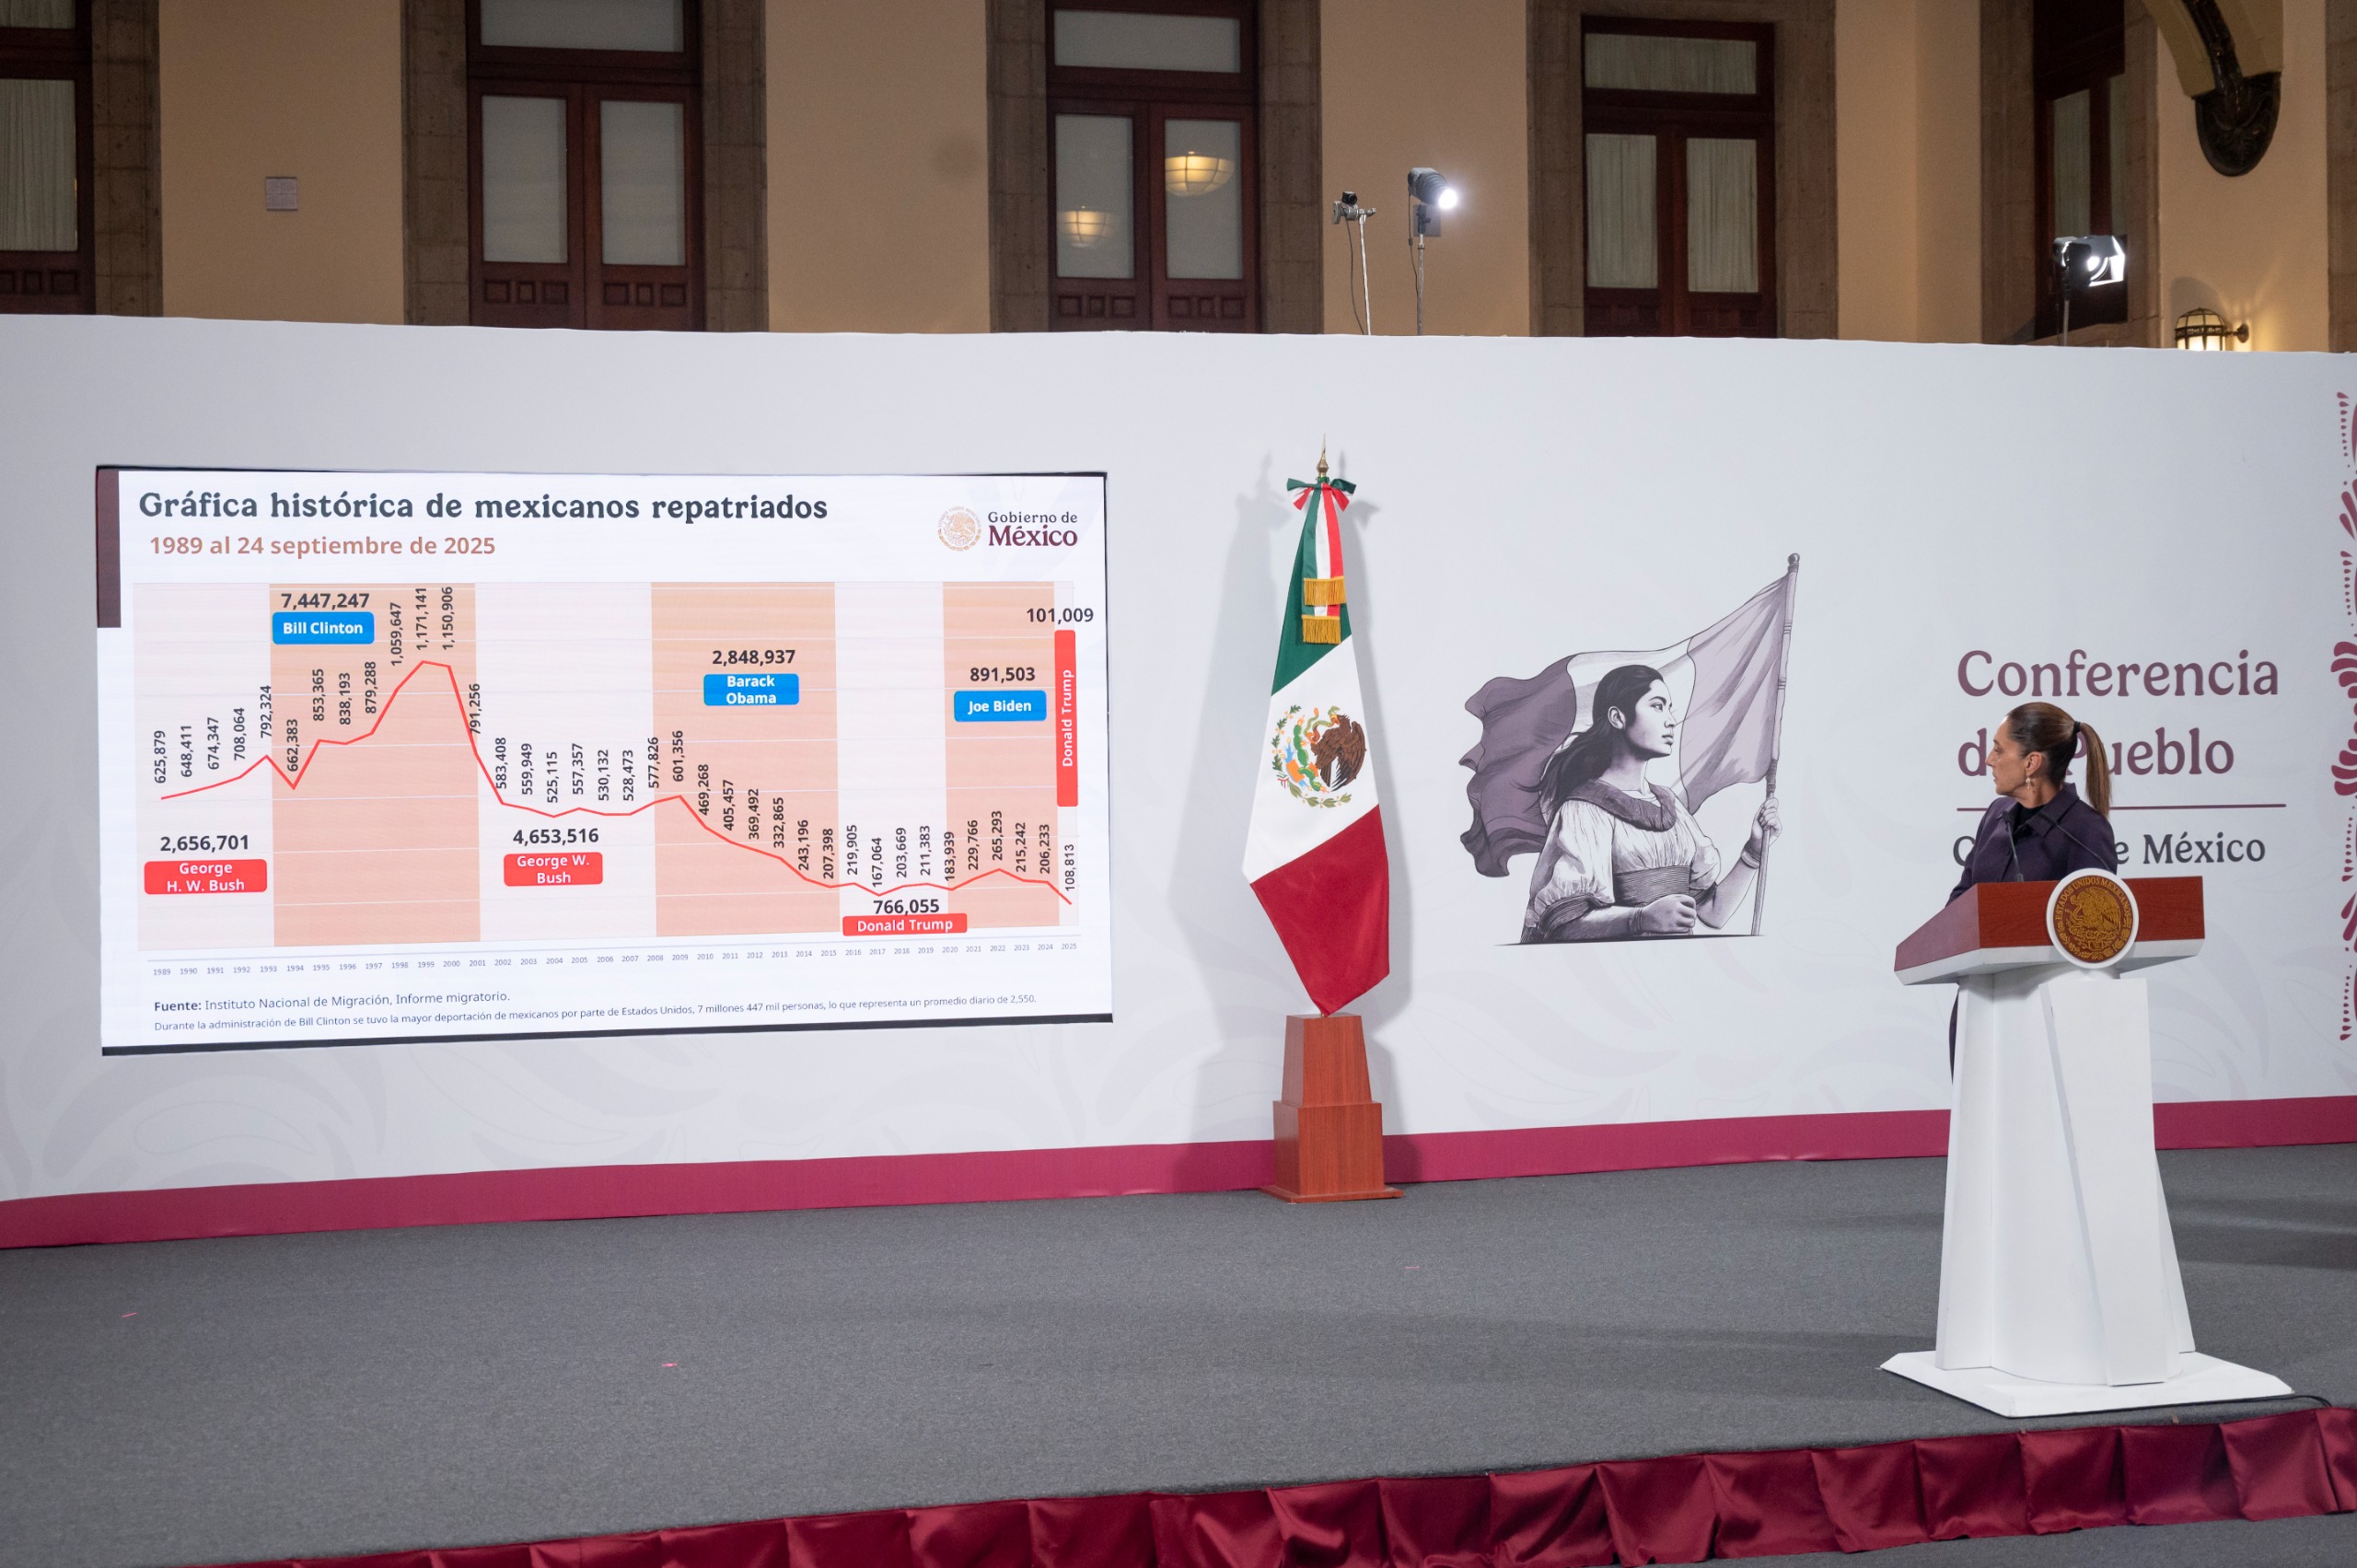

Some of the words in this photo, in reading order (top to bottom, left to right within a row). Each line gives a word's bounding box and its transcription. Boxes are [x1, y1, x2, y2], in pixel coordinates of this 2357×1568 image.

[139, 489, 258, 517] Gráfica
[270, 490, 413, 518] histórica
[425, 492, 462, 518] de
[474, 493, 640, 519] mexicanos
[651, 494, 828, 525] repatriados
[987, 511, 1057, 524] Gobierno
[1061, 511, 1078, 524] de
[150, 536, 203, 554] 1989
[210, 536, 230, 554] al
[238, 537, 264, 554] 24
[271, 536, 402, 560] septiembre
[410, 536, 437, 555] de
[444, 537, 495, 555] 2025
[988, 524, 1078, 547] México
[280, 592, 371, 611] 7,447,247
[283, 621, 307, 634] Bill
[310, 621, 363, 634] Clinton
[414, 587, 430, 651] 1,171,141
[441, 586, 456, 651] 1,150,906
[1026, 607, 1095, 625] 101,009
[389, 601, 404, 667] 1,059,647
[712, 649, 796, 668] 2,848,937
[311, 668, 327, 722] 853,365
[364, 661, 378, 714] 879,288
[726, 674, 776, 689] Barack
[726, 691, 778, 705] Obama
[970, 666, 1036, 684] 891,503
[1062, 668, 1075, 714] Trump
[1957, 648, 2279, 697] Conferencia
[259, 684, 274, 739] 792,324
[338, 672, 353, 726] 838,193
[468, 682, 482, 735] 791,256
[968, 701, 990, 715] Joe
[993, 700, 1032, 712] Biden
[153, 730, 168, 784] 625,879
[180, 726, 194, 778] 648,411
[206, 716, 221, 771] 674,347
[233, 707, 248, 761] 708,064
[285, 718, 300, 772] 662,383
[671, 729, 686, 783] 601,356
[1062, 718, 1074, 767] Donald
[494, 737, 509, 790] 583,408
[520, 742, 535, 796] 559,949
[545, 751, 560, 804] 525,115
[571, 742, 586, 796] 557,357
[597, 749, 611, 802] 530,132
[621, 749, 636, 802] 528,473
[646, 737, 661, 789] 577,826
[697, 763, 712, 817] 469,268
[722, 779, 736, 831] 405,457
[747, 788, 761, 841] 369,492
[159, 834, 249, 854] 2,656,701
[512, 827, 599, 847] 4,653,516
[772, 796, 786, 849] 332,865
[796, 819, 811, 871] 243,196
[967, 819, 981, 871] 229,766
[991, 810, 1004, 862] 265,293
[1015, 821, 1028, 873] 215,242
[2114, 841, 2130, 865] e
[2142, 830, 2266, 865] México
[179, 862, 233, 877] George
[517, 852, 568, 870] George
[571, 854, 590, 866] W.
[821, 828, 836, 879] 207,398
[845, 824, 860, 876] 219,905
[871, 837, 884, 889] 167,064
[895, 827, 909, 878] 203,669
[919, 825, 933, 877] 211,383
[943, 830, 957, 882] 183,939
[1039, 823, 1051, 875] 206,233
[1063, 843, 1077, 892] 108,813
[167, 880, 181, 892] H.
[186, 880, 204, 892] W.
[209, 878, 245, 891] Bush
[537, 871, 571, 884] Bush
[2055, 886, 2074, 920] ESTADOS
[2073, 877, 2100, 890] UNIDOS
[2100, 877, 2131, 917] MEXICANOS
[857, 919, 905, 933] Donald
[909, 919, 953, 934] Trump
[873, 898, 940, 916] 766,055
[153, 968, 171, 976] 1989
[180, 967, 198, 975] 1990
[206, 966, 225, 975] 1991
[233, 966, 251, 974] 1992
[260, 965, 278, 973] 1993
[286, 964, 305, 972] 1994
[365, 962, 383, 970] 1997
[391, 961, 409, 970] 1998
[417, 960, 435, 969] 1999
[442, 959, 461, 968] 2000
[469, 958, 486, 968] 2001
[493, 958, 512, 967] 2002
[520, 958, 538, 966] 2003
[545, 957, 563, 965] 2004
[621, 955, 639, 963] 2007
[646, 954, 664, 962] 2008
[671, 953, 689, 961] 2009
[722, 952, 739, 960] 2011
[747, 951, 763, 959] 2012
[772, 950, 788, 958] 2013
[844, 948, 863, 957] 2016
[869, 947, 887, 956] 2017
[917, 947, 935, 955] 2019
[942, 946, 958, 954] 2020
[966, 945, 981, 953] 2021
[1014, 944, 1030, 952] 2023
[1037, 943, 1053, 951] 2024
[154, 1001, 202, 1012] Fuente:
[204, 999, 256, 1010] Instituto
[259, 996, 310, 1008] Nacional
[313, 996, 328, 1007] de
[331, 994, 393, 1009] Migración,
[396, 993, 443, 1005] Informe
[446, 991, 510, 1005] migratorio.
[154, 1022, 195, 1031] Durante
[197, 1020, 206, 1029] la
[208, 1018, 282, 1029] administración
[284, 1017, 297, 1028] de
[298, 1016, 314, 1027] Bill
[316, 1016, 351, 1027] Clinton
[353, 1016, 365, 1025] se
[366, 1016, 389, 1025] tuvo
[389, 1014, 400, 1024] la
[401, 1015, 433, 1025] mayor
[434, 1011, 493, 1024] deportación
[493, 1010, 507, 1020] de
[508, 1010, 560, 1020] mexicanos
[561, 1010, 578, 1020] por
[580, 1008, 606, 1020] parte
[607, 1007, 620, 1016] de
[621, 1006, 658, 1016] Estados
[659, 1005, 695, 1015] Unidos,
[697, 1005, 703, 1014] 7
[705, 1004, 745, 1014] millones
[746, 1003, 764, 1012] 447
[765, 1002, 780, 1012] mil
[782, 1003, 827, 1013] personas,
[829, 1000, 838, 1009] lo
[839, 1001, 857, 1011] que
[858, 999, 908, 1010] representa
[910, 999, 922, 1007] un
[923, 996, 968, 1008] promedio
[969, 995, 995, 1005] diario
[996, 995, 1009, 1005] de
[1010, 994, 1037, 1005] 2,550.
